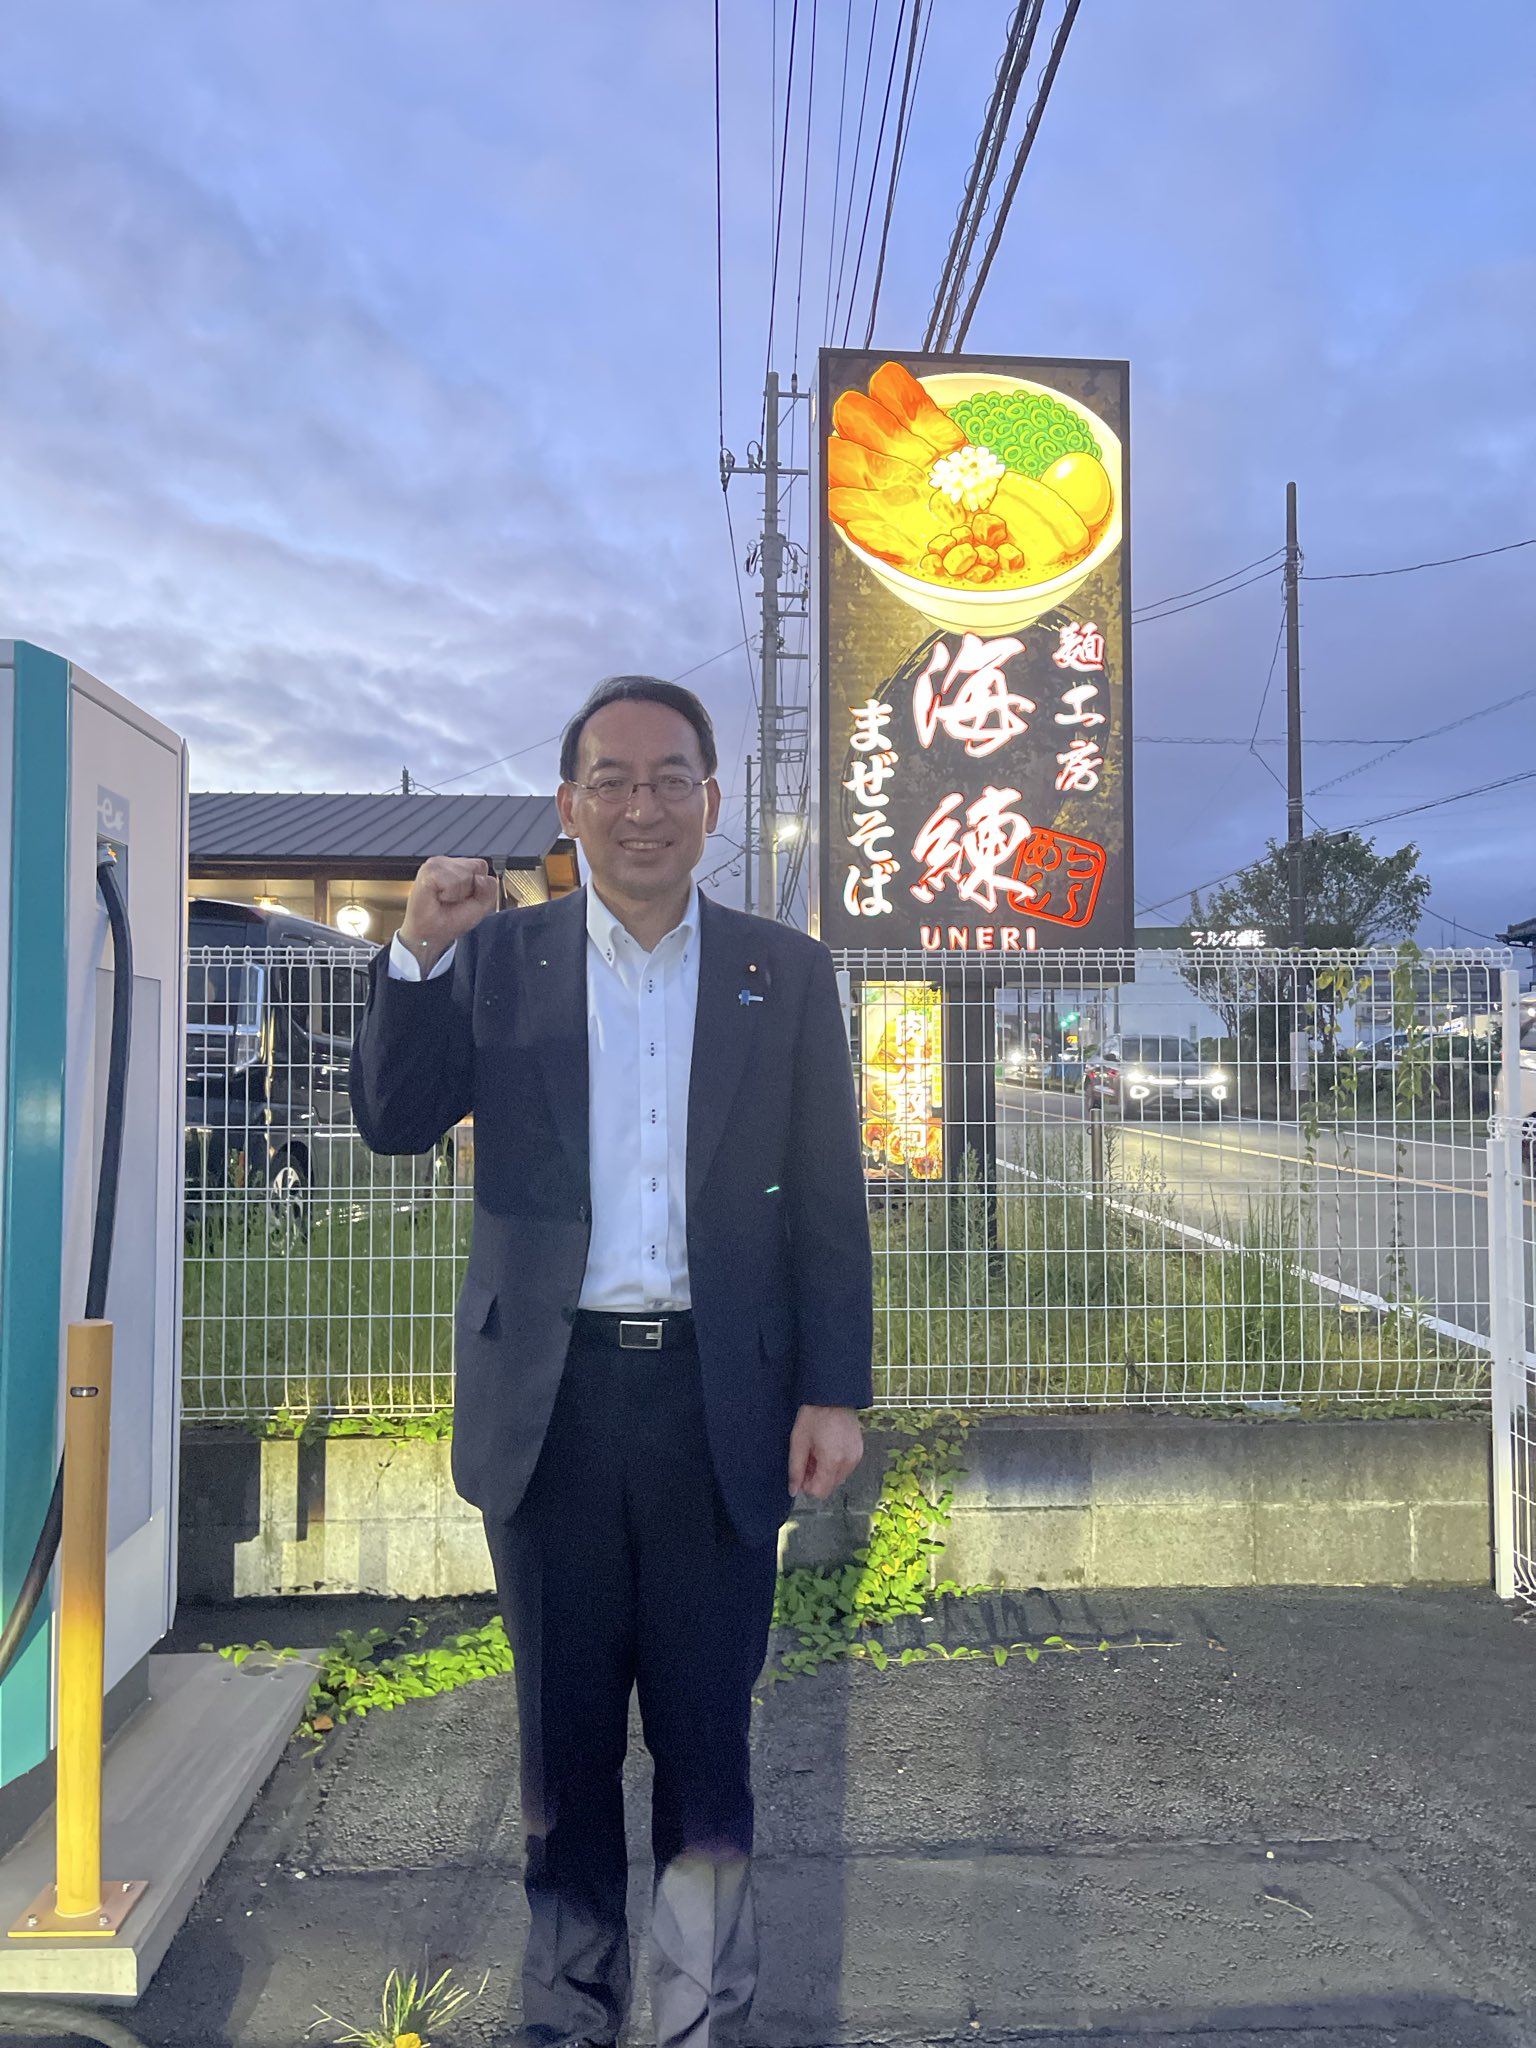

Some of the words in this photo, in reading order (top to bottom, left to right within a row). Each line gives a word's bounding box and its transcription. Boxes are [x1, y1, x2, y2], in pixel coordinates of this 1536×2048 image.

[842, 698, 900, 916] まぜそば
[919, 926, 1036, 950] UNERI
